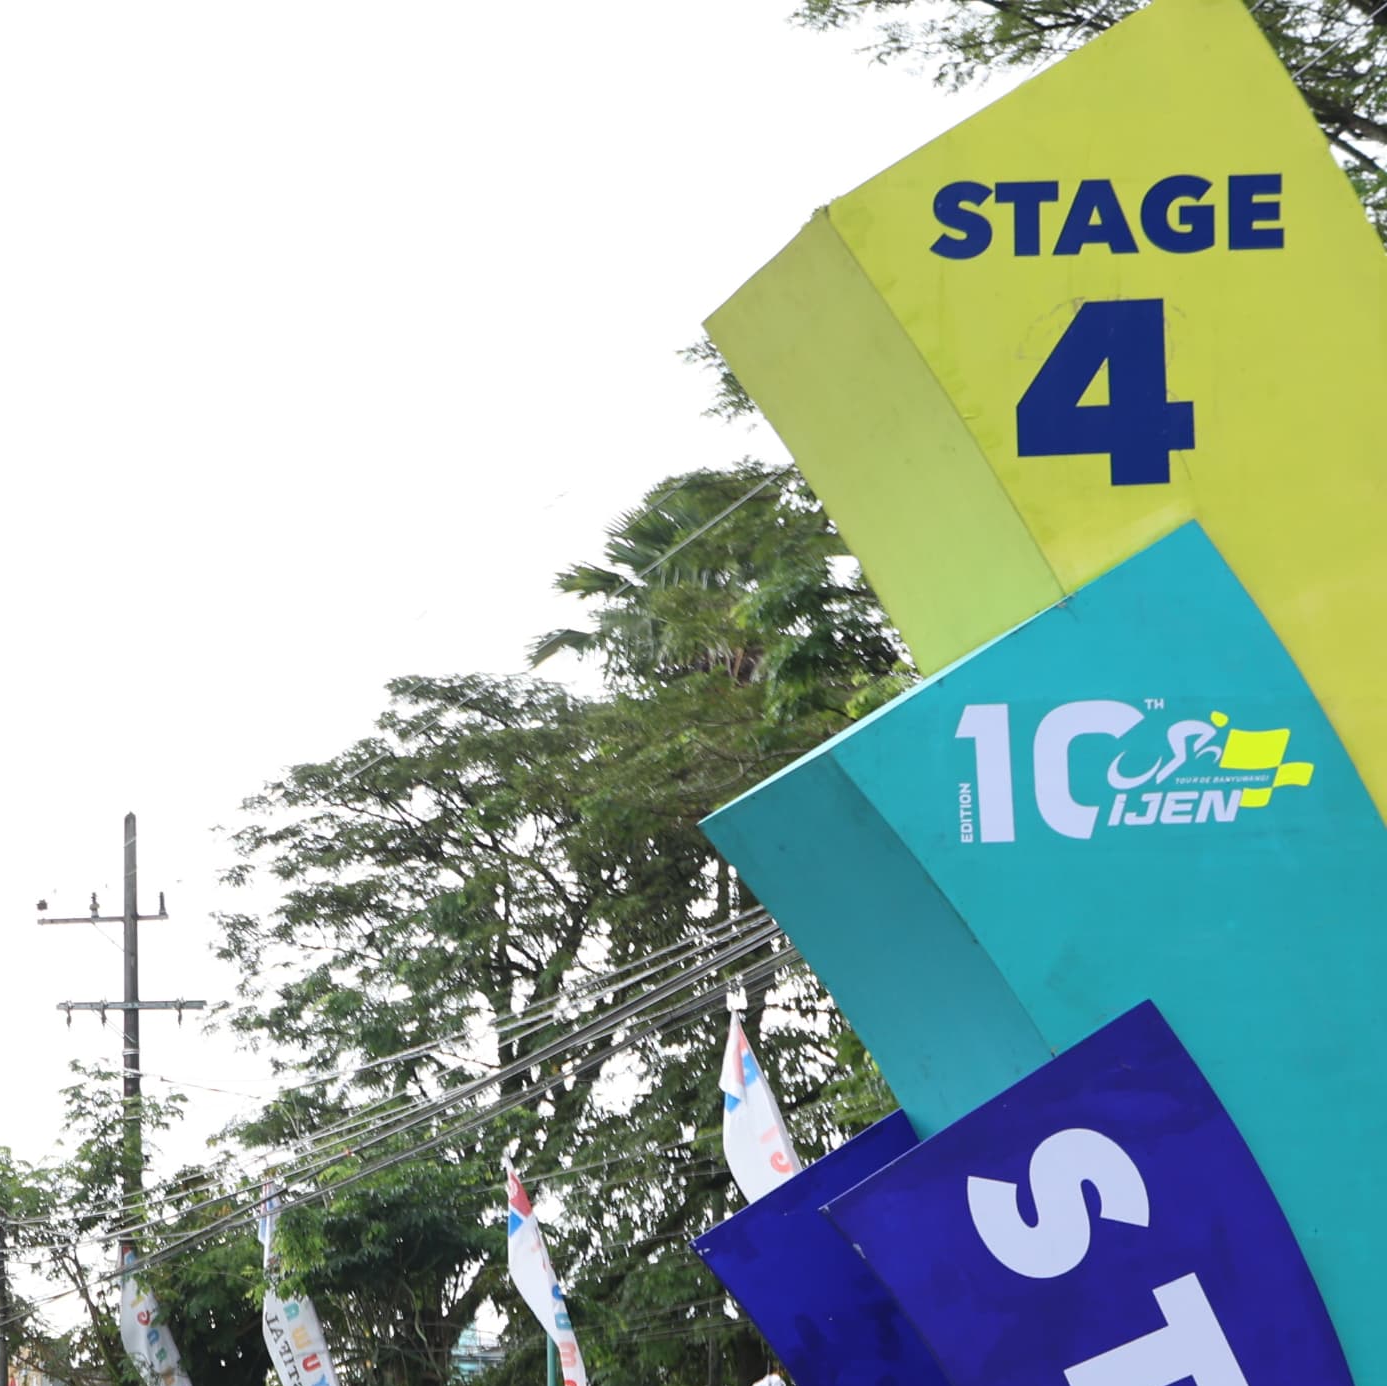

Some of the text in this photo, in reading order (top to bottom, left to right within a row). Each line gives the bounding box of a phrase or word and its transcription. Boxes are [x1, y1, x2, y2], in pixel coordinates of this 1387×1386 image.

[929, 173, 1285, 259] STAGE
[1016, 297, 1196, 487] 4
[1145, 698, 1164, 710] TH
[959, 782, 974, 843] EDITION
